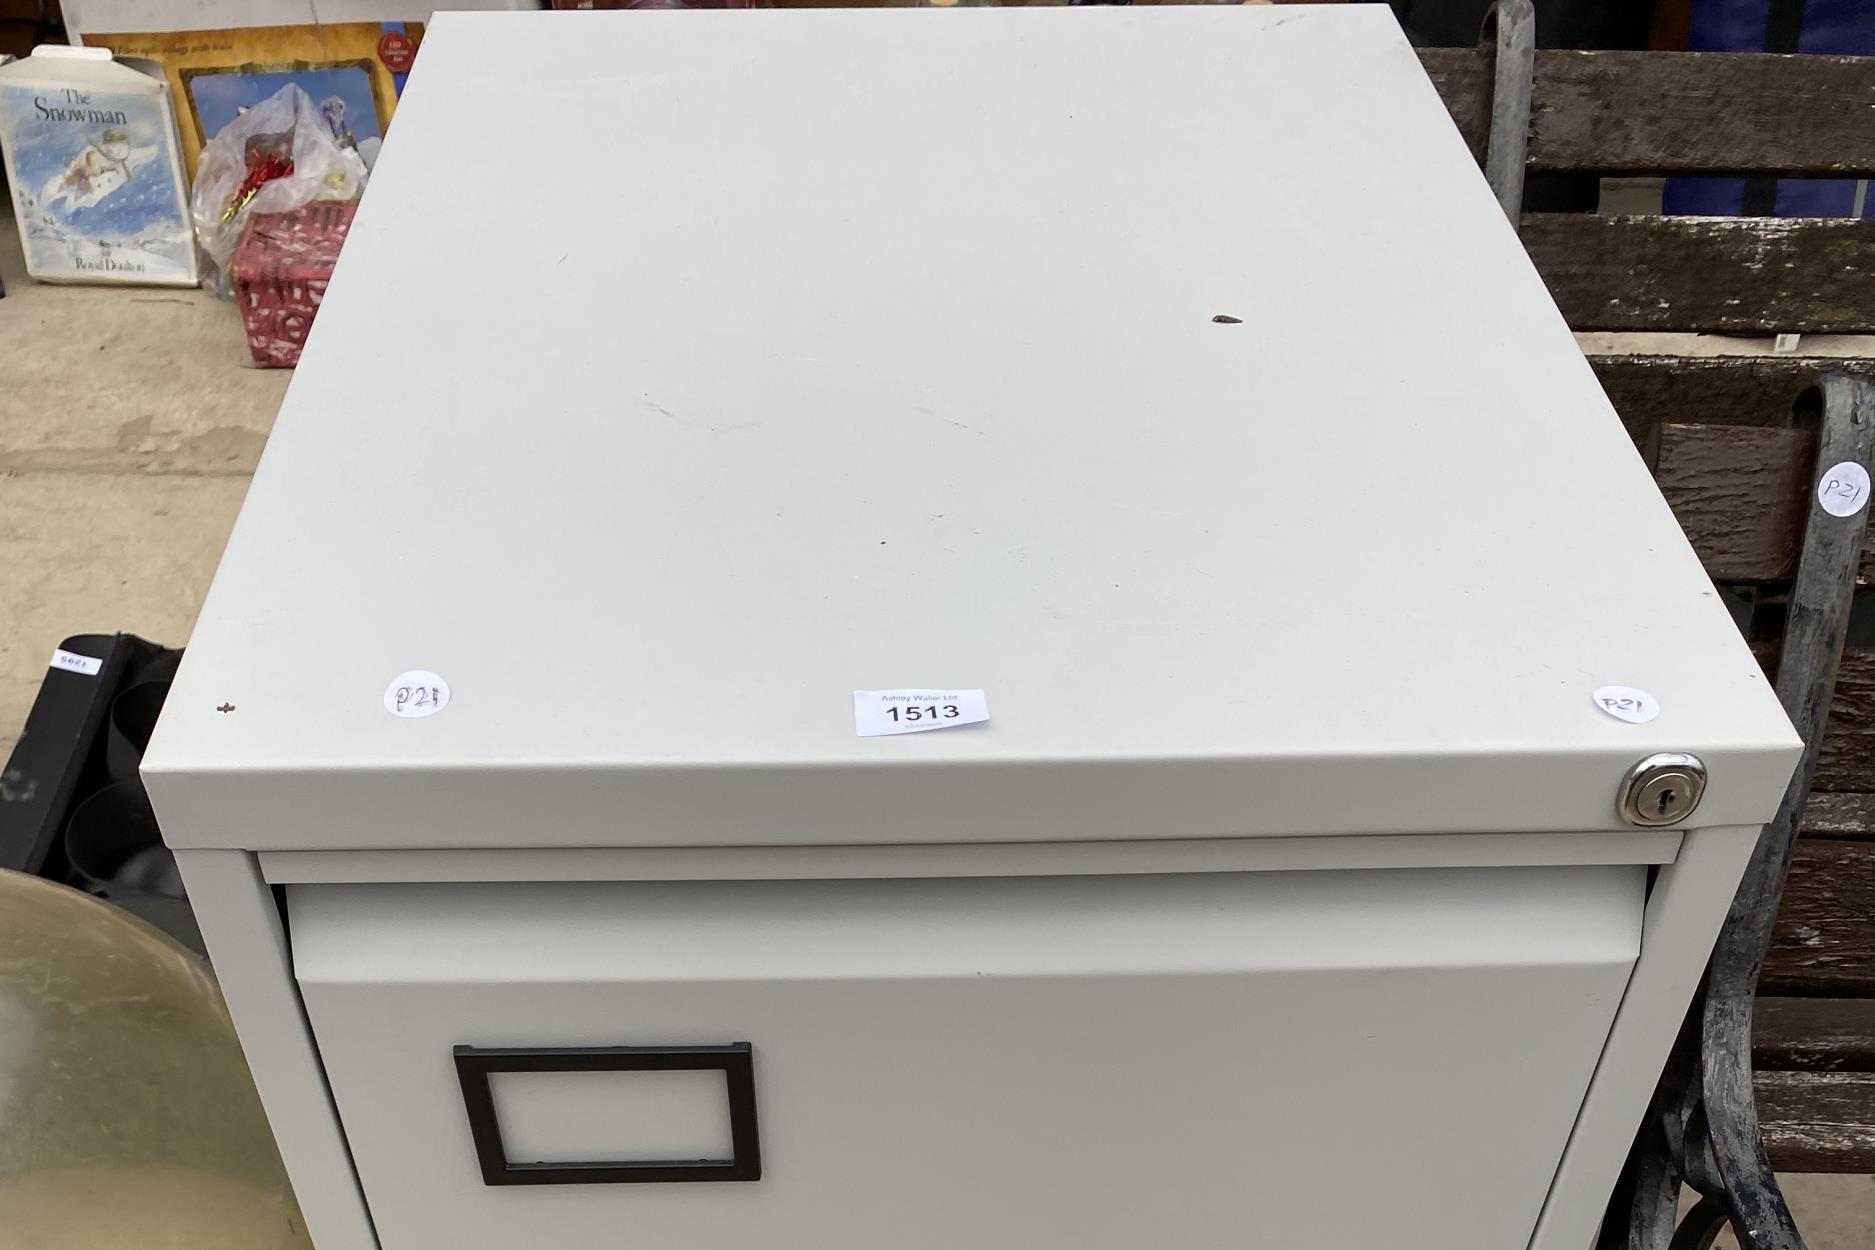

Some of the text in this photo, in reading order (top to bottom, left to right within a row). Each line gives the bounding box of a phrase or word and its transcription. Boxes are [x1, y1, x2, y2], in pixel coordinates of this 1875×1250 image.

[61, 88, 90, 104] The
[34, 96, 127, 124] Snowman
[1824, 480, 1861, 503] P21
[886, 705, 960, 721] 1513
[1602, 698, 1643, 712] P21
